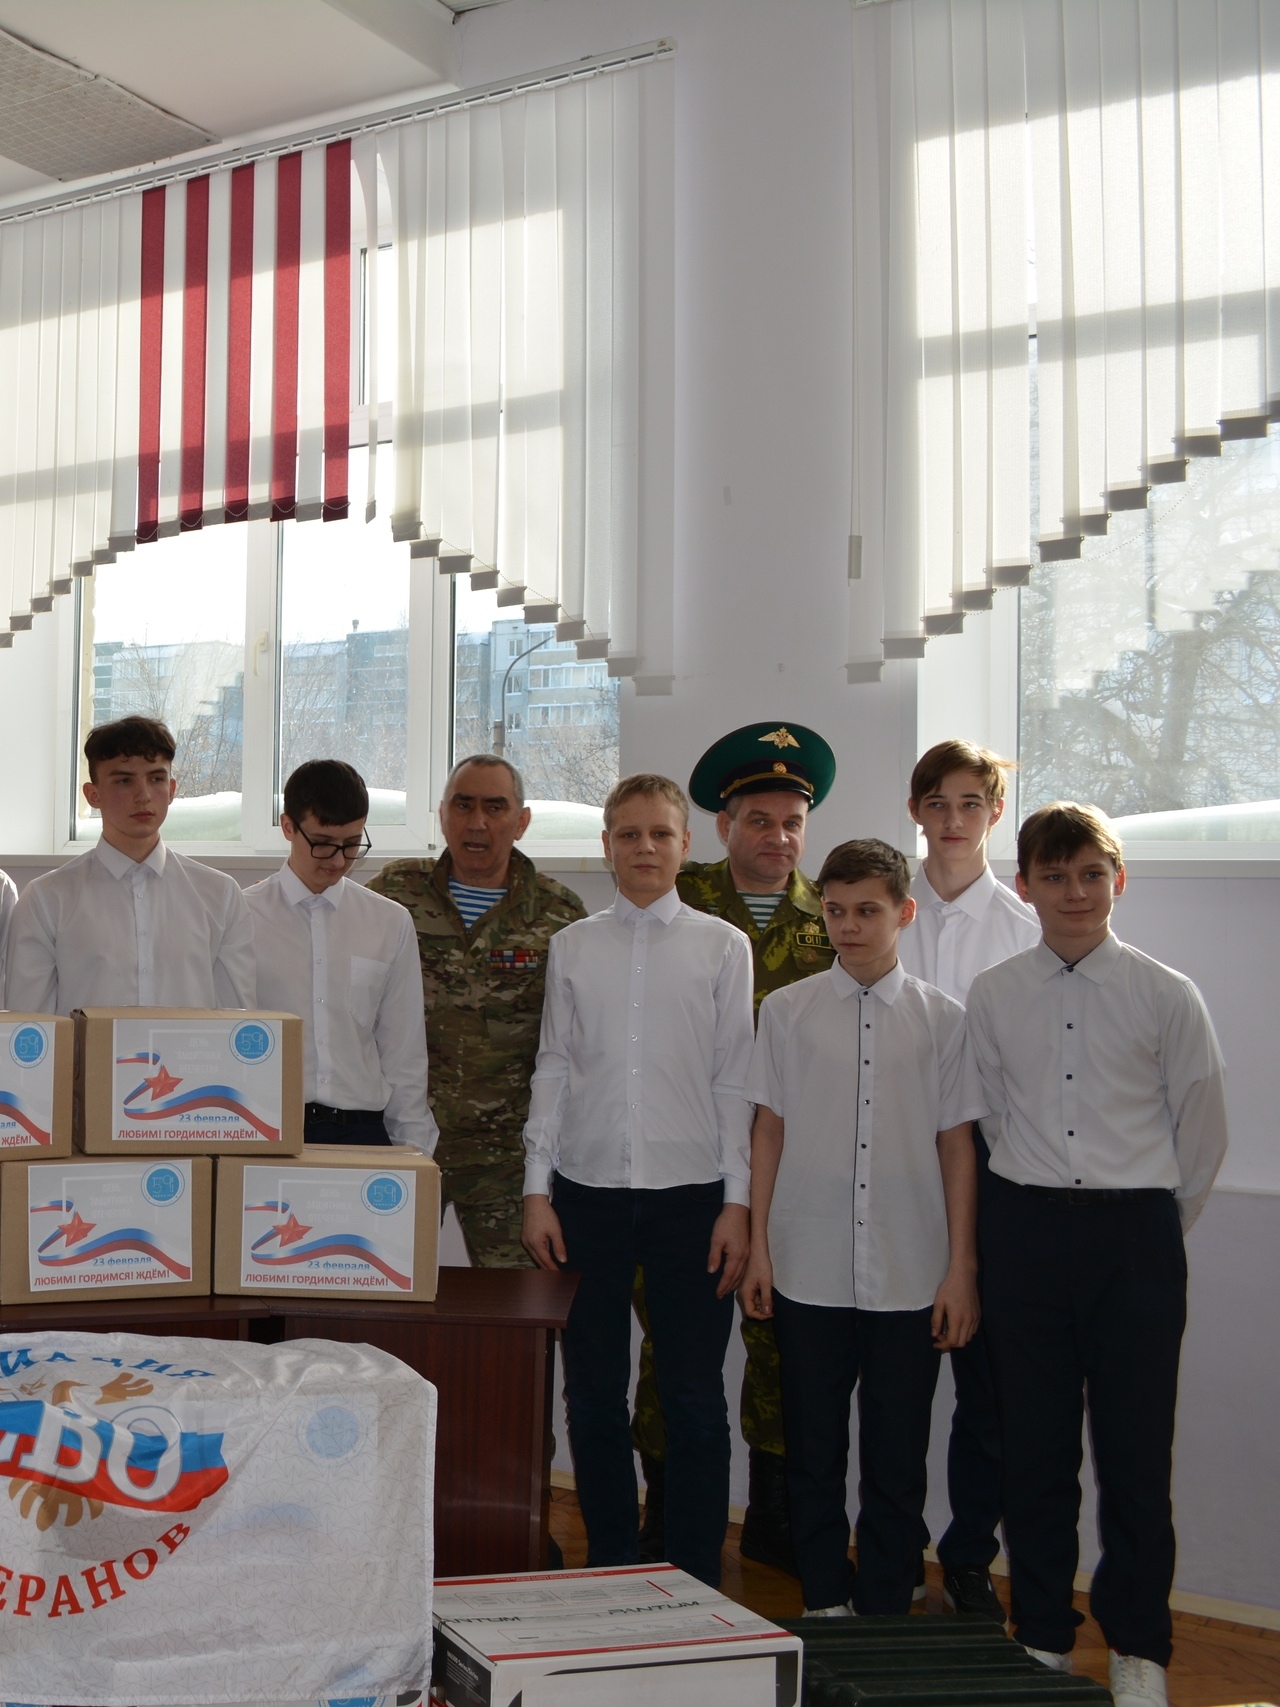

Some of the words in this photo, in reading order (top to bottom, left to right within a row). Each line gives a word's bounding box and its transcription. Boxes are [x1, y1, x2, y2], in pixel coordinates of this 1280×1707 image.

[178, 1113, 192, 1123] 23
[193, 1113, 240, 1124] февраля
[1, 1134, 32, 1146] ЖДЁМ!
[118, 1129, 162, 1140] ЛЮБИМ!
[164, 1129, 221, 1140] ГОРДИМСЯ!
[223, 1128, 258, 1140] ЖДЁМ!
[92, 1257, 106, 1267] 23
[107, 1255, 152, 1267] февраля
[307, 1260, 320, 1269] 23
[322, 1260, 370, 1271] февраля
[34, 1274, 76, 1287] ЛЮБИМ!
[78, 1271, 134, 1285] ГОРДИМСЯ!
[135, 1268, 170, 1280] ЖДЁМ!
[245, 1272, 289, 1284] ЛЮБИМ!
[291, 1274, 350, 1286] ГОРДИМСЯ!
[352, 1274, 389, 1287] ЖДЁМ!
[607, 1600, 700, 1616] PANTUM
[441, 1614, 521, 1625] ANTUM
